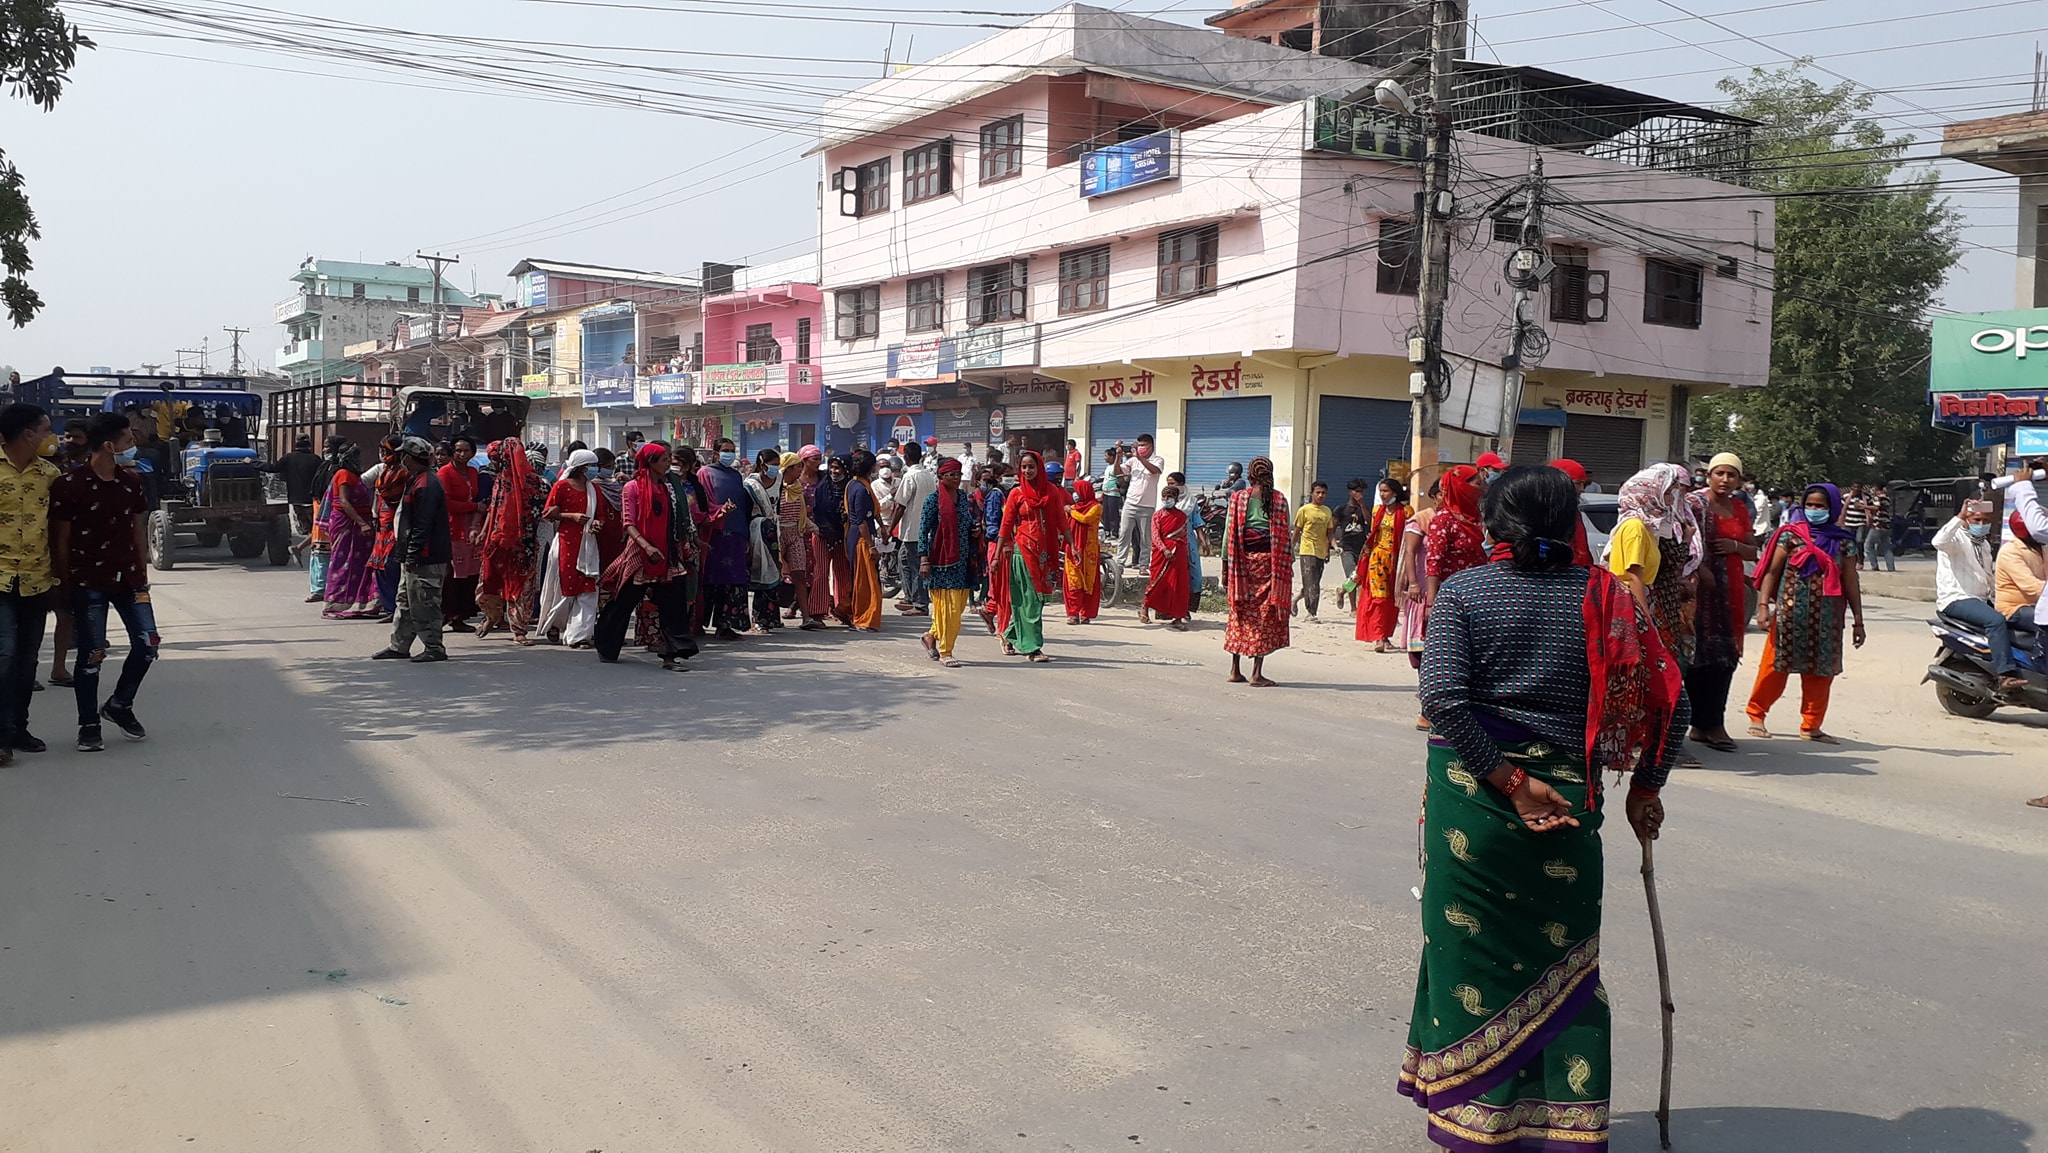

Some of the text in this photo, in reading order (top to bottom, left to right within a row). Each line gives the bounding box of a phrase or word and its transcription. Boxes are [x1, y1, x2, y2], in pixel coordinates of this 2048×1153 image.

[1191, 361, 1241, 397] ट्रेडर्स
[1616, 387, 1648, 409] ट्रेडर्स
[1939, 393, 2039, 417] निहारिका
[990, 418, 1004, 428] Gulf
[894, 428, 914, 442] Gulf
